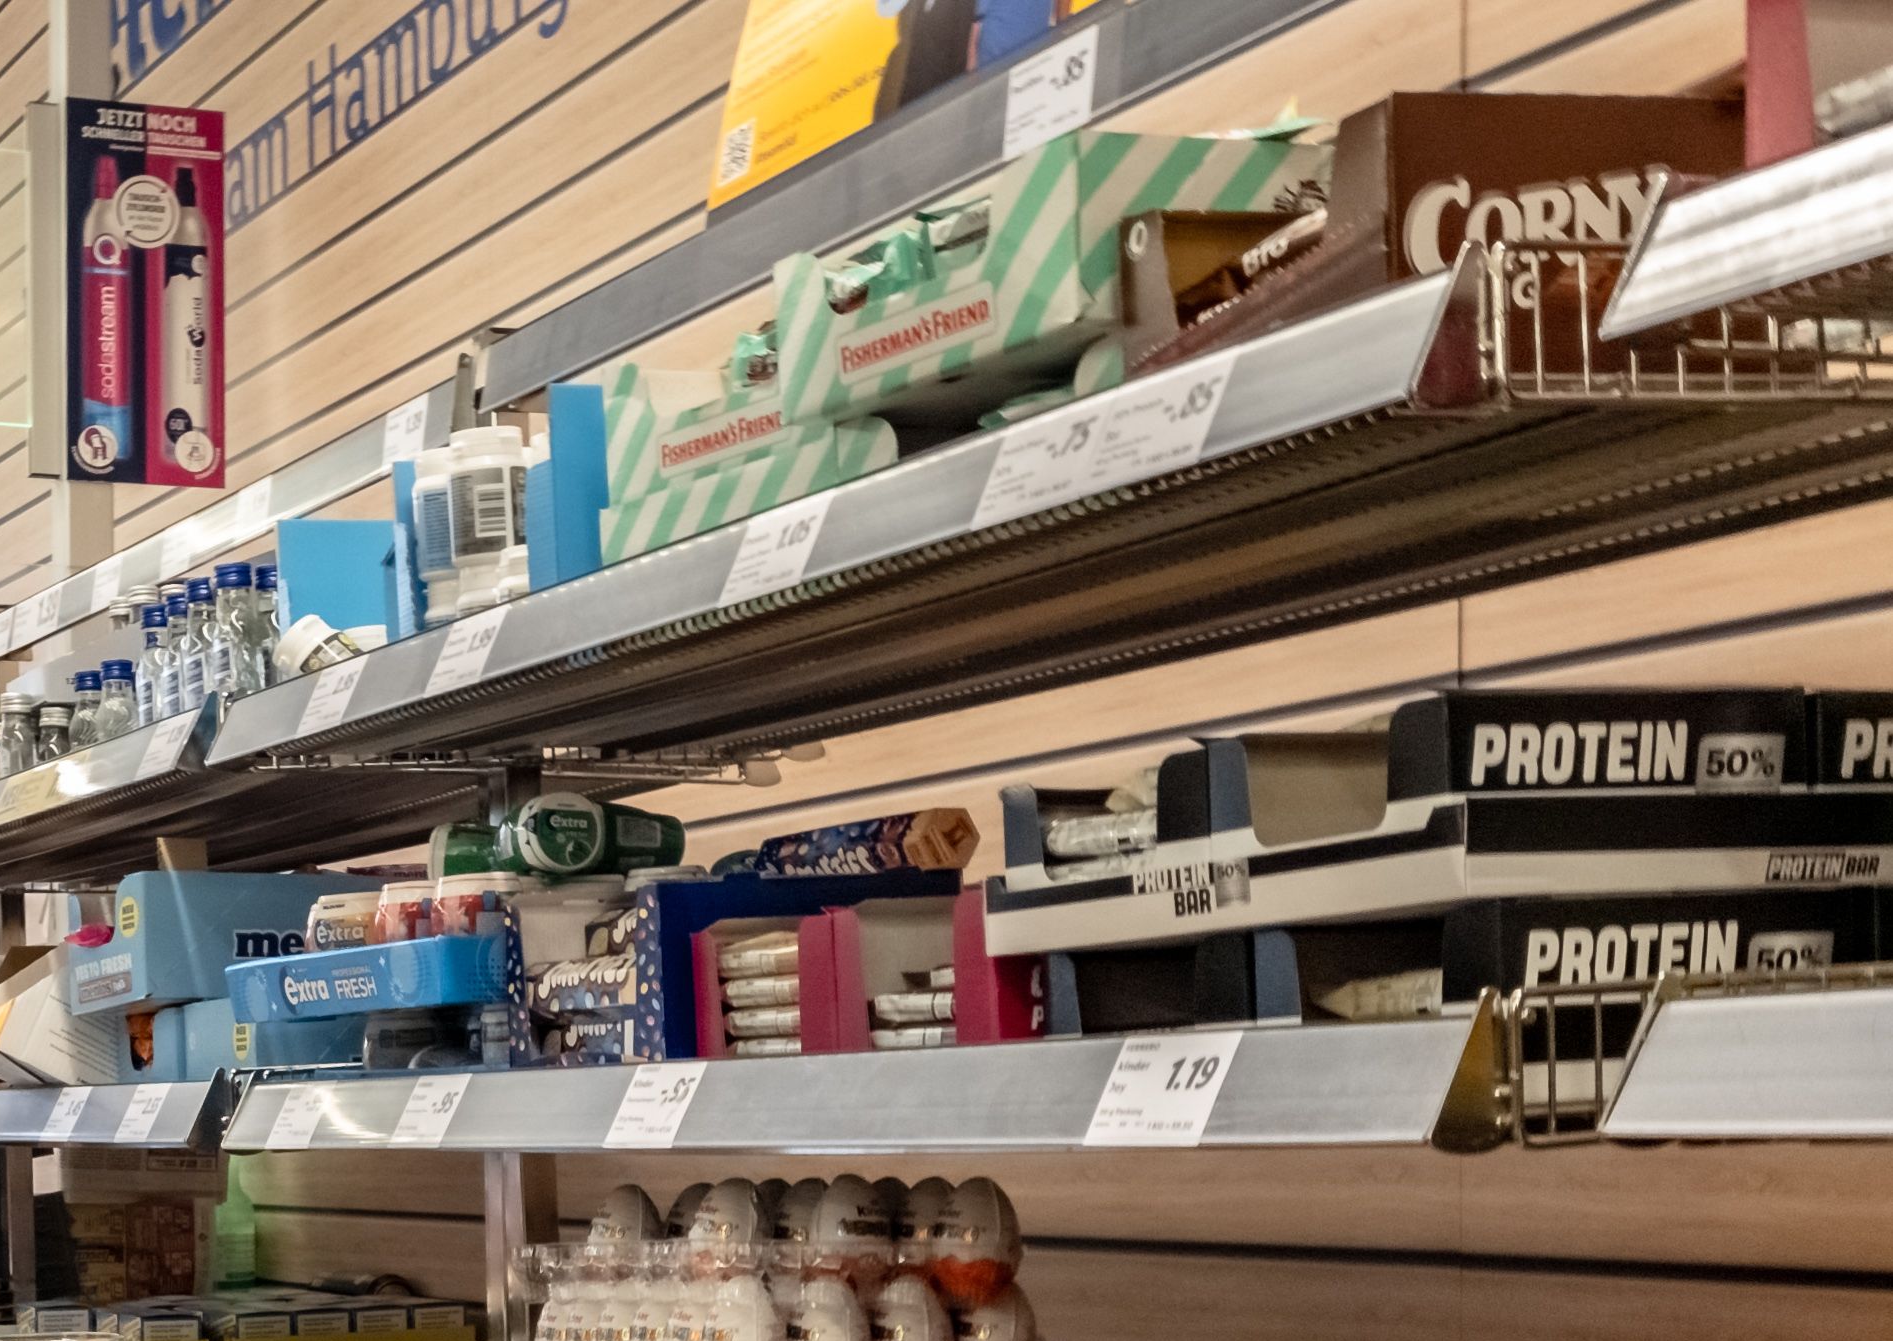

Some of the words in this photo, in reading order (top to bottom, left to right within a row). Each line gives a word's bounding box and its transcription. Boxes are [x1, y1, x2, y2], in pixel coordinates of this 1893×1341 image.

[307, 0, 570, 169] Hambu
[96, 108, 145, 128] JETZT
[147, 113, 197, 133] NOCH
[98, 286, 116, 399] sodastream
[841, 314, 935, 374] FISHERMAN'S
[932, 297, 990, 342] FRIEND
[661, 425, 738, 468] FISHERMAN'S
[1471, 720, 1688, 787] PROTEIN
[1706, 748, 1775, 779] 50%
[549, 815, 588, 829] extra
[1133, 862, 1211, 895] PROTEIN
[1767, 855, 1845, 880] PROTEIN
[1174, 890, 1212, 917] BAR
[316, 923, 365, 944] extra
[1525, 920, 1738, 990] PROTEIN
[284, 976, 329, 1005] extra
[334, 976, 378, 1000] FRESH
[1165, 1056, 1220, 1091] 1.19
